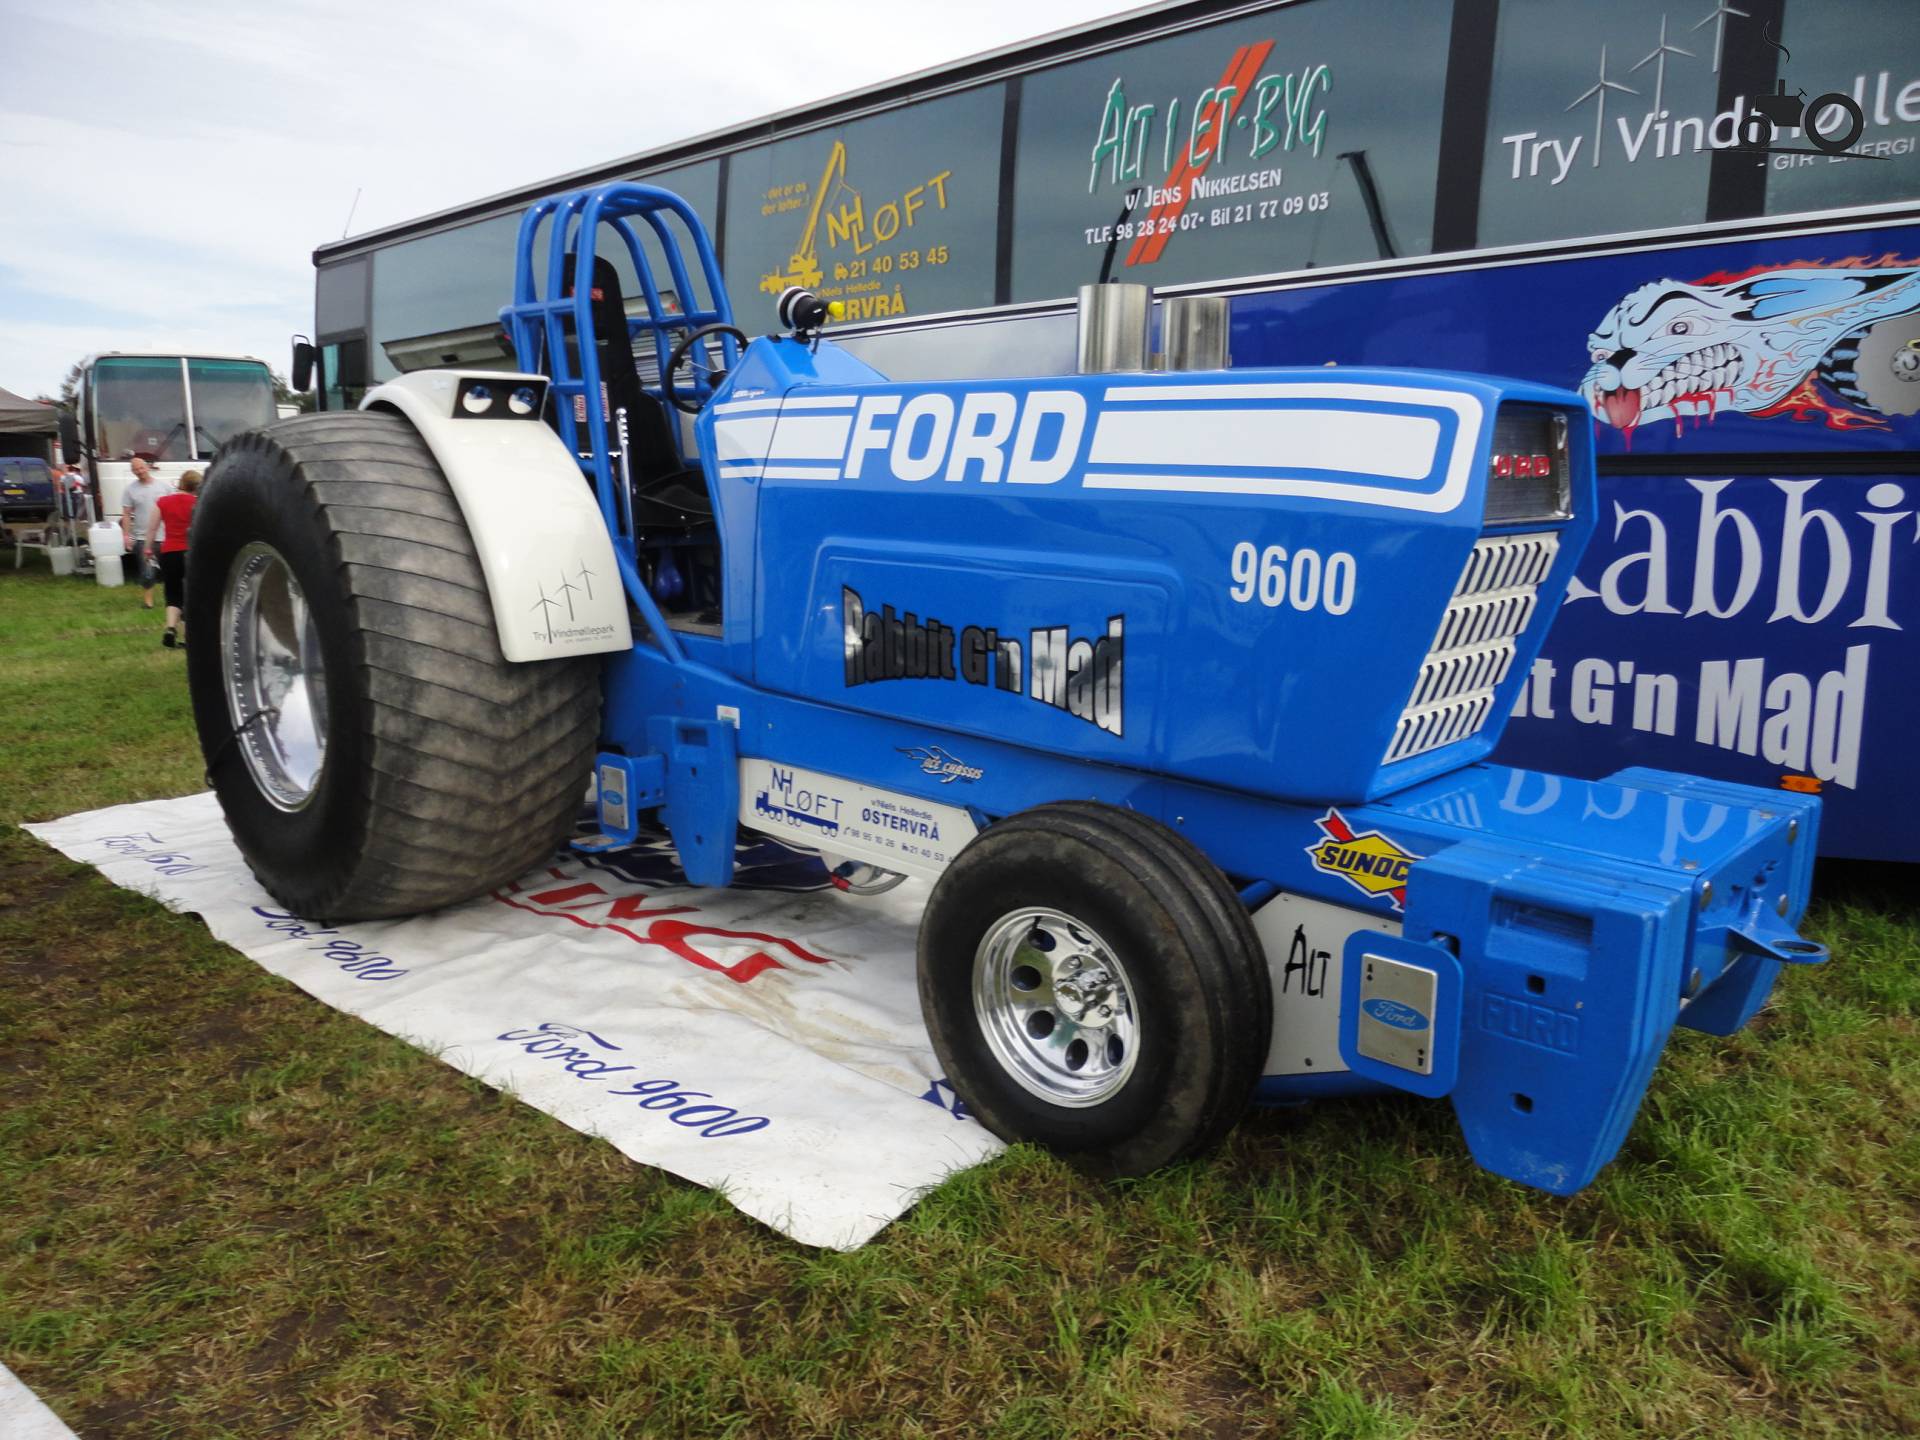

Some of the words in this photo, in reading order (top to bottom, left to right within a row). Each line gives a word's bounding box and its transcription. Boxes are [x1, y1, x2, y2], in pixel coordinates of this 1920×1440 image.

[1191, 168, 1282, 200] NIKKELSEN
[1502, 132, 1583, 186] Try
[1085, 228, 1113, 245] TLF.
[1116, 223, 1133, 240] 98
[1137, 219, 1155, 237] 28
[1159, 216, 1177, 234] 24
[1211, 208, 1230, 227] Bil
[1235, 204, 1253, 222] 21
[1260, 200, 1278, 219] 77
[1283, 196, 1304, 215] 09
[1308, 192, 1329, 211] 03
[850, 261, 866, 278] 21
[872, 255, 893, 273] 40
[899, 251, 920, 270] 53
[926, 246, 948, 264] 45
[843, 390, 1088, 485] FORD
[1230, 541, 1357, 616] 9600
[1563, 478, 1920, 631] abbi
[842, 584, 956, 688] Rabbit
[1030, 613, 1125, 740] Mad
[1571, 657, 1678, 736] G'n
[1695, 644, 1870, 790] Mad
[862, 808, 940, 841] ØSTERVRÅ
[1321, 845, 1409, 882] SUNOC
[497, 1022, 637, 1081] Ford
[608, 1079, 771, 1138] 9600
